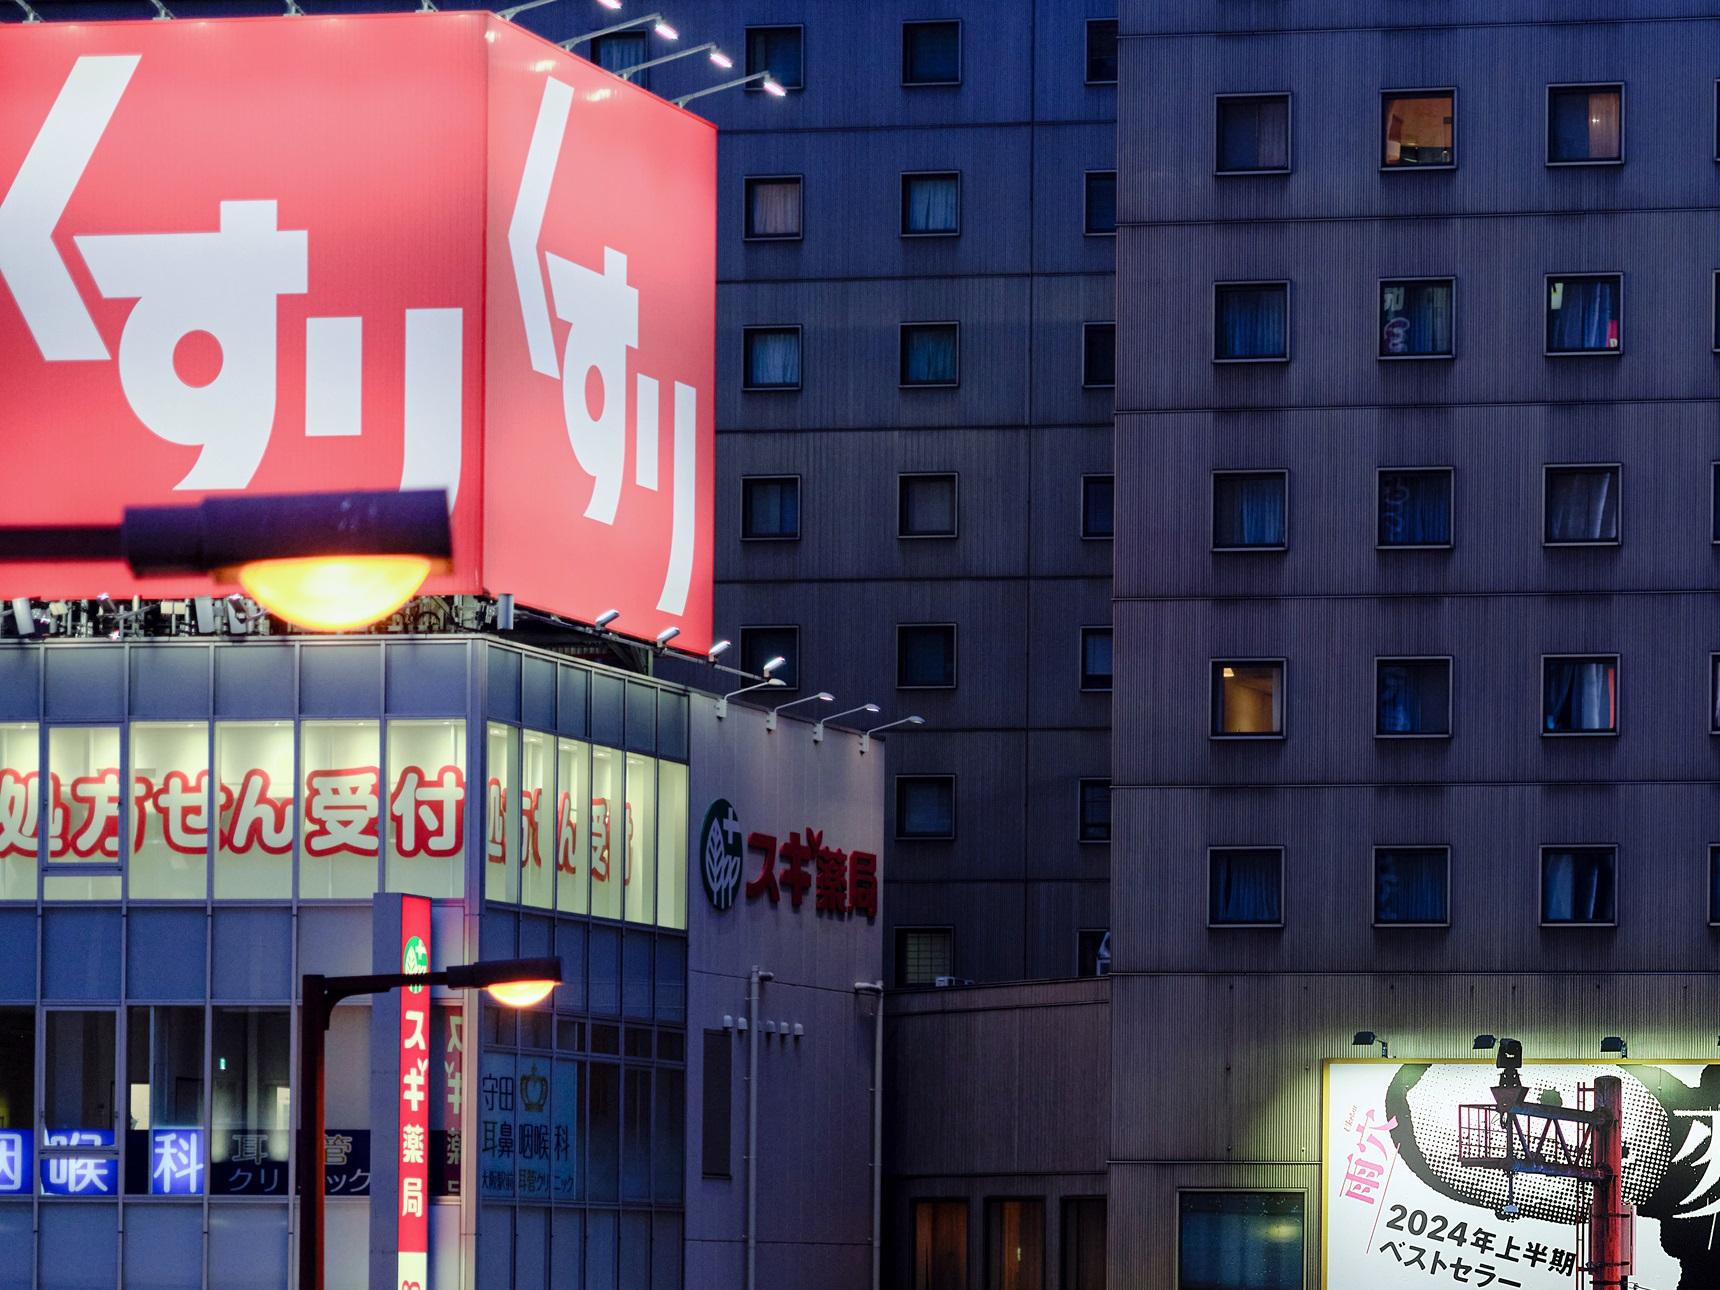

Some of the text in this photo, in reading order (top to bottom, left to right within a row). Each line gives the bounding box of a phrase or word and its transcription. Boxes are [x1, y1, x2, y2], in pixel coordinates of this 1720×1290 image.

[0, 54, 463, 515] くすり
[508, 76, 697, 618] くすり
[746, 827, 878, 918] スギ薬局
[402, 1010, 428, 1217] スギ薬局
[482, 1074, 514, 1111] 守田
[229, 1168, 370, 1193] クリック
[1344, 1108, 1399, 1205] 雨穴
[1379, 1239, 1522, 1290] ベストセラー
[1386, 1204, 1577, 1277] 2024年上半期
